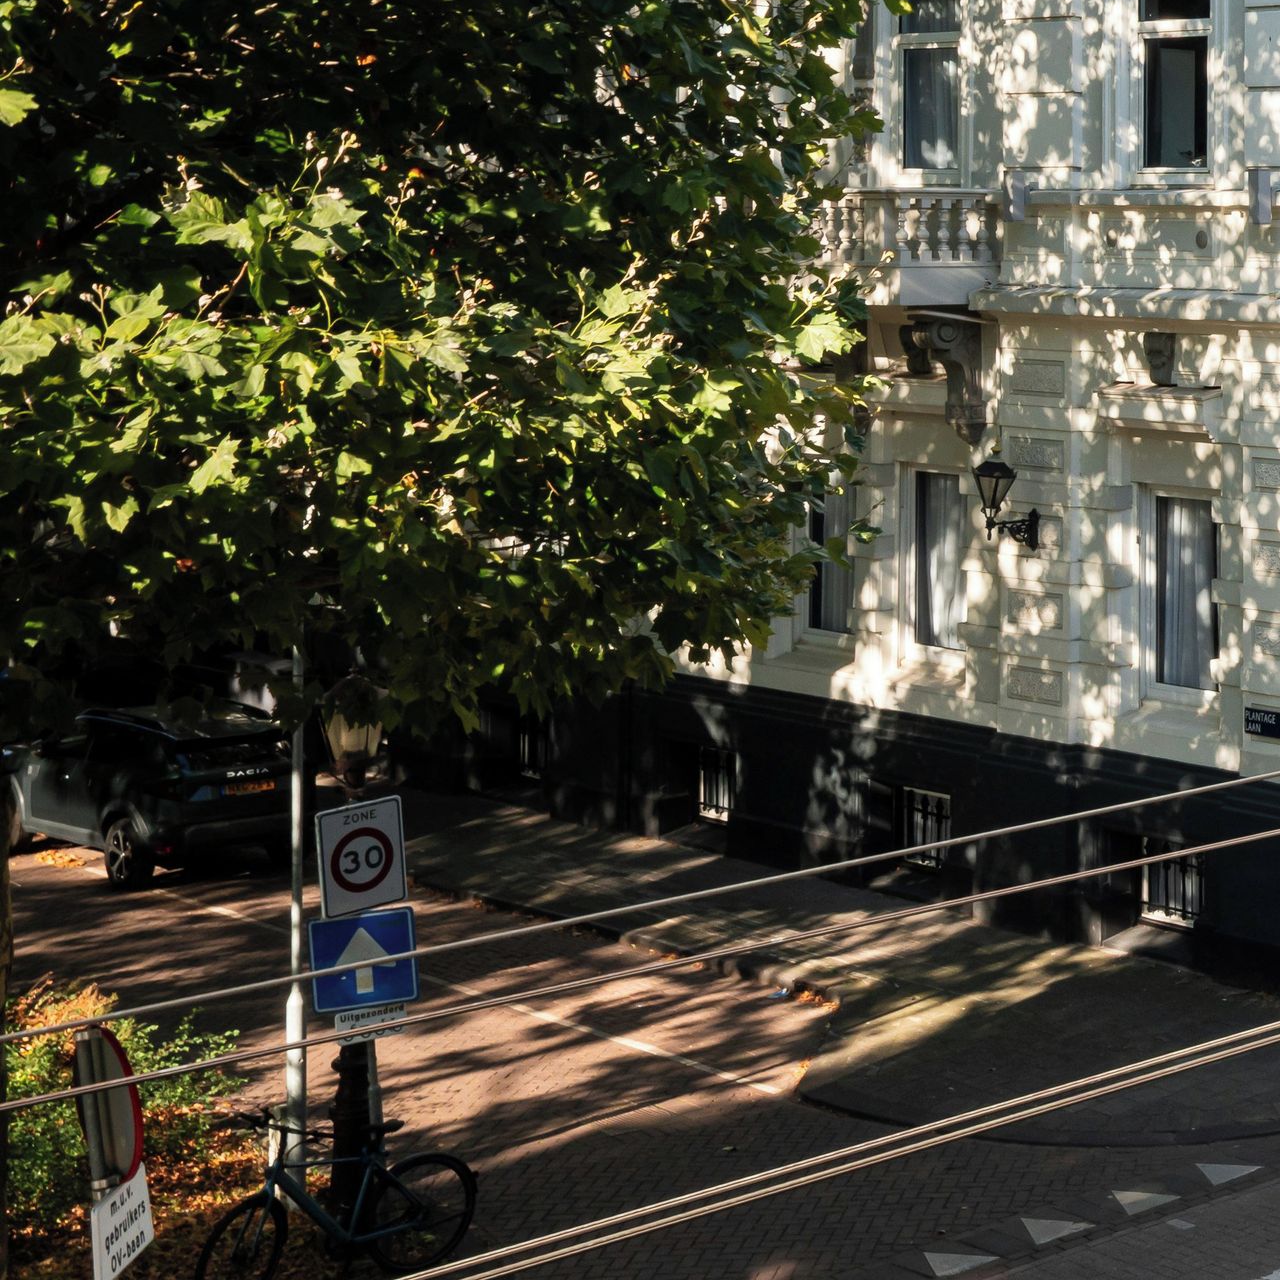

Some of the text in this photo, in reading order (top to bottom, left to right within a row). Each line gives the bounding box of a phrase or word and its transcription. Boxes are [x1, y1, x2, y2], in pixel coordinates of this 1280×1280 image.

[1245, 710, 1276, 725] PLANTAGE
[226, 767, 270, 778] DACIA
[343, 808, 377, 826] ZONE
[342, 845, 384, 874] 30
[340, 1003, 405, 1023] Uitgezonderd
[110, 1184, 134, 1218] m.u.v.
[105, 1200, 146, 1255] gebruikers
[111, 1230, 146, 1273] OV-baan
